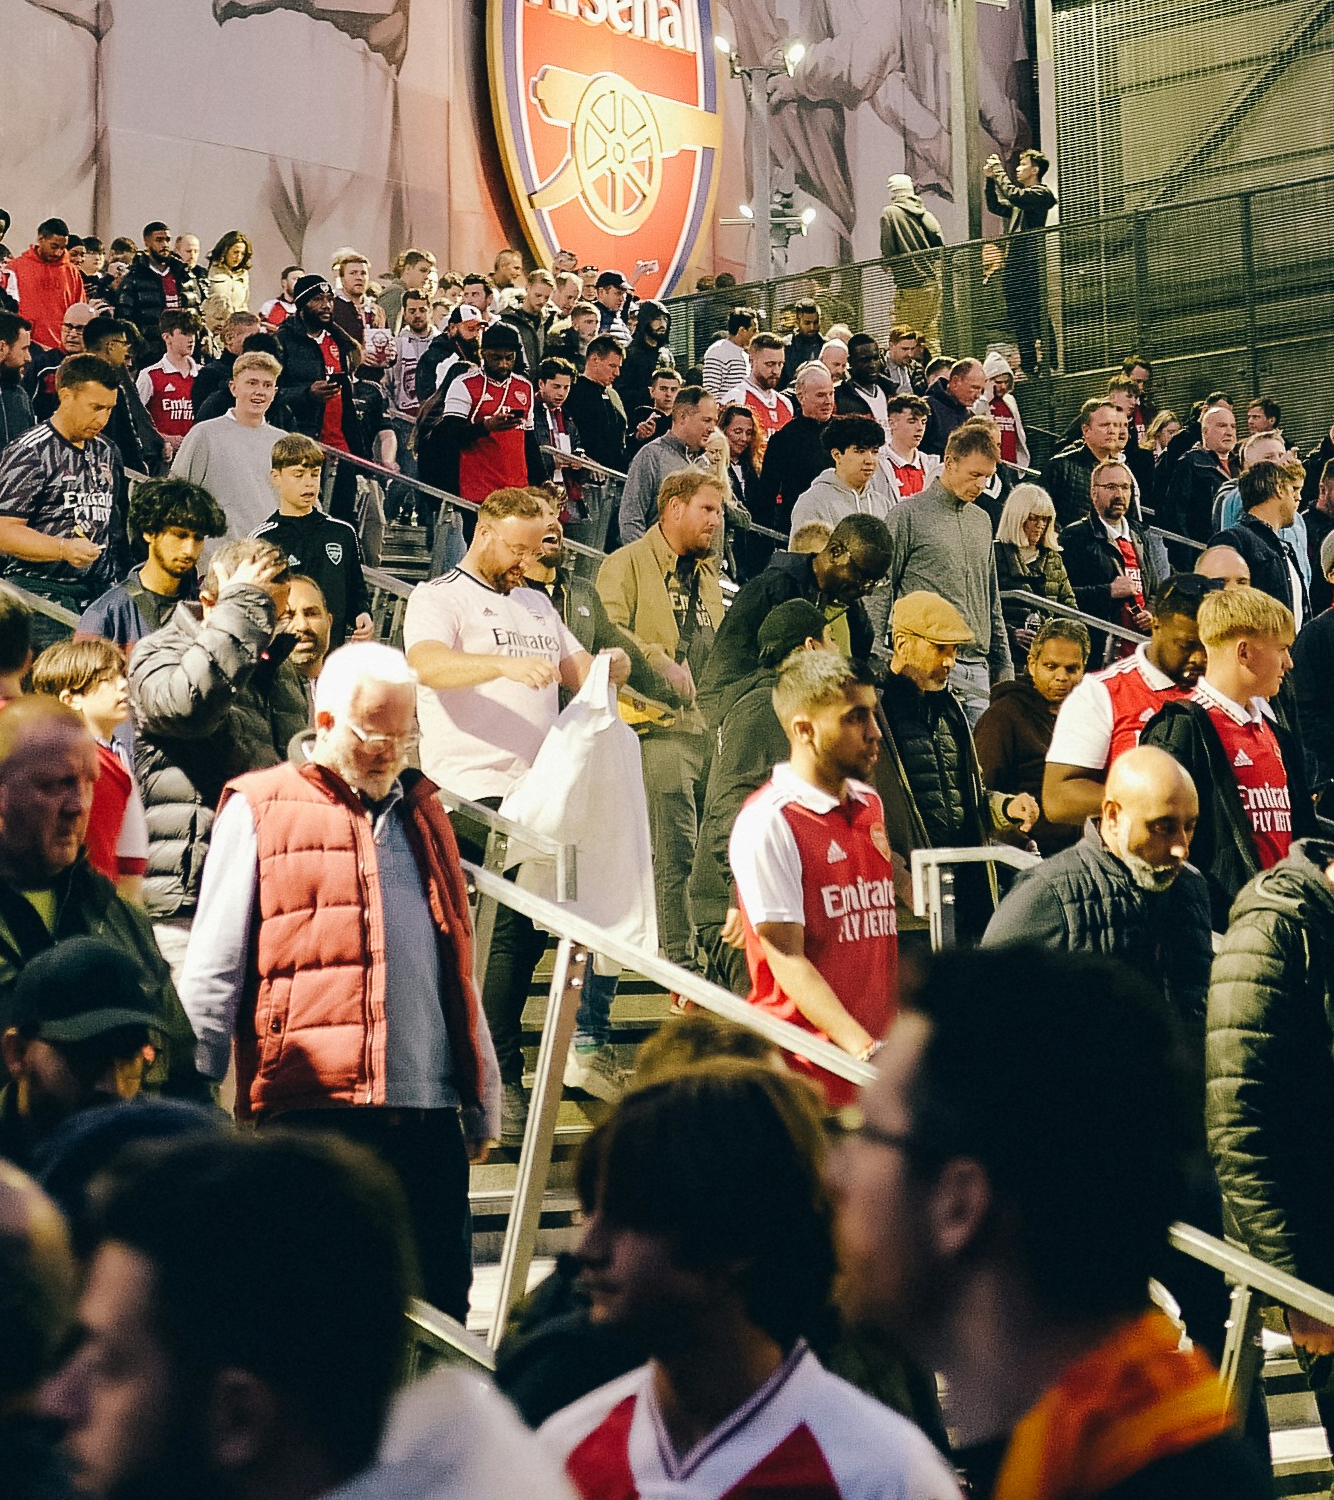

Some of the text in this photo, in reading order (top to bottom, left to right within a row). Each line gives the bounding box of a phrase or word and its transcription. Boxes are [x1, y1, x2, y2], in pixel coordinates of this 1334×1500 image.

[162, 396, 193, 411] Emira
[491, 627, 560, 653] Emirates
[1236, 781, 1291, 810] mirat
[820, 875, 896, 918] Emirat
[838, 913, 860, 943] LY
